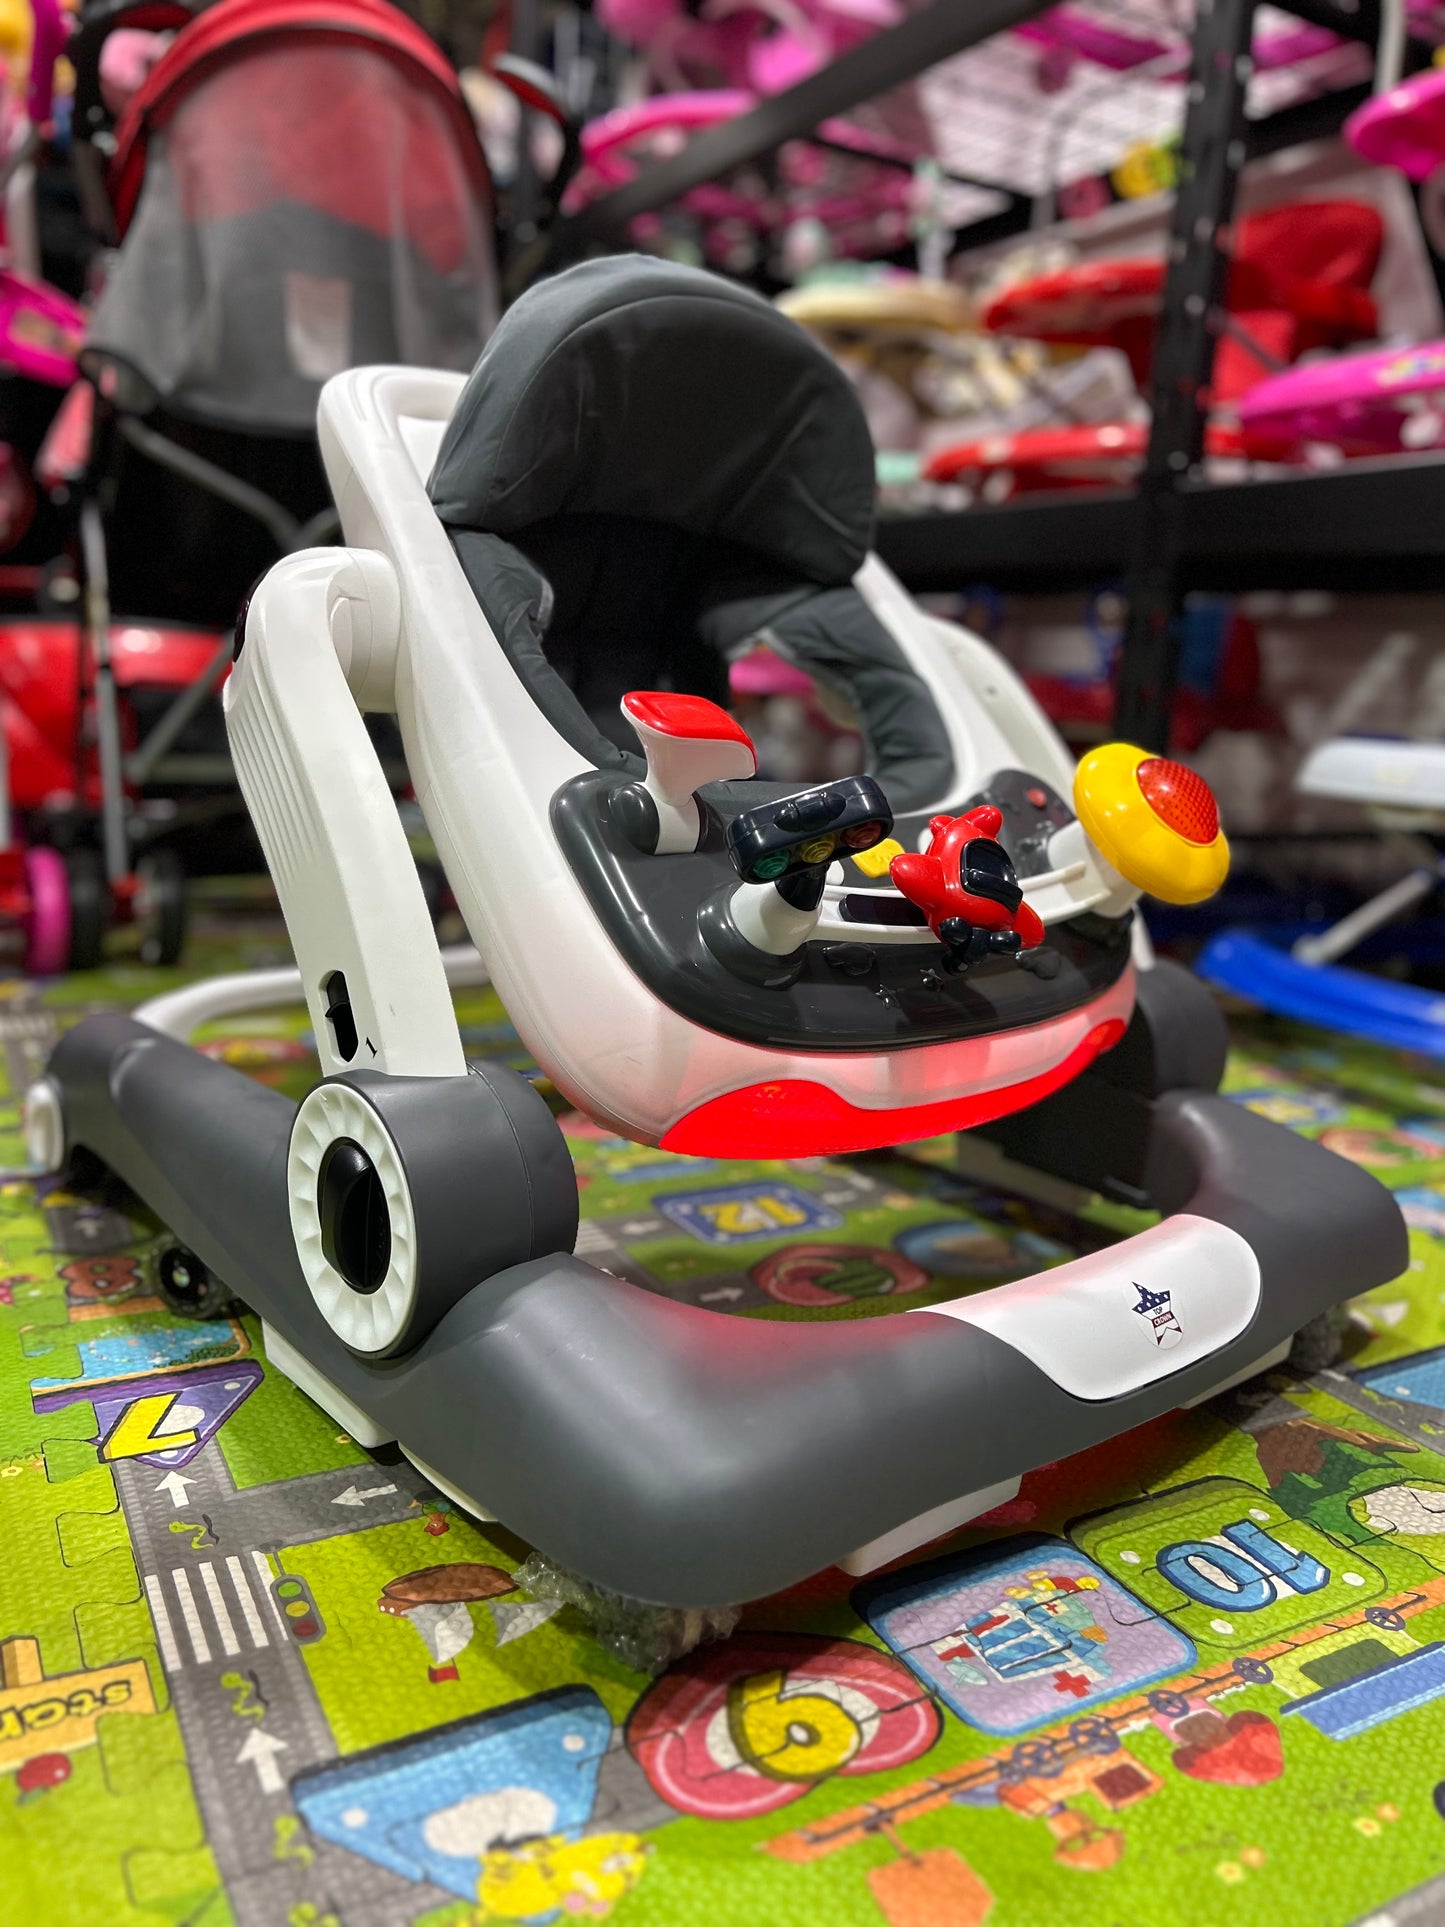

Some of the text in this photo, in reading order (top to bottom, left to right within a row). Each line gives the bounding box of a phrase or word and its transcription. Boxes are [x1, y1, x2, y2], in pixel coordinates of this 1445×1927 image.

[365, 1036, 378, 1059] 1
[1153, 1306, 1163, 1316] TOP
[1156, 1518, 1331, 1613] 10
